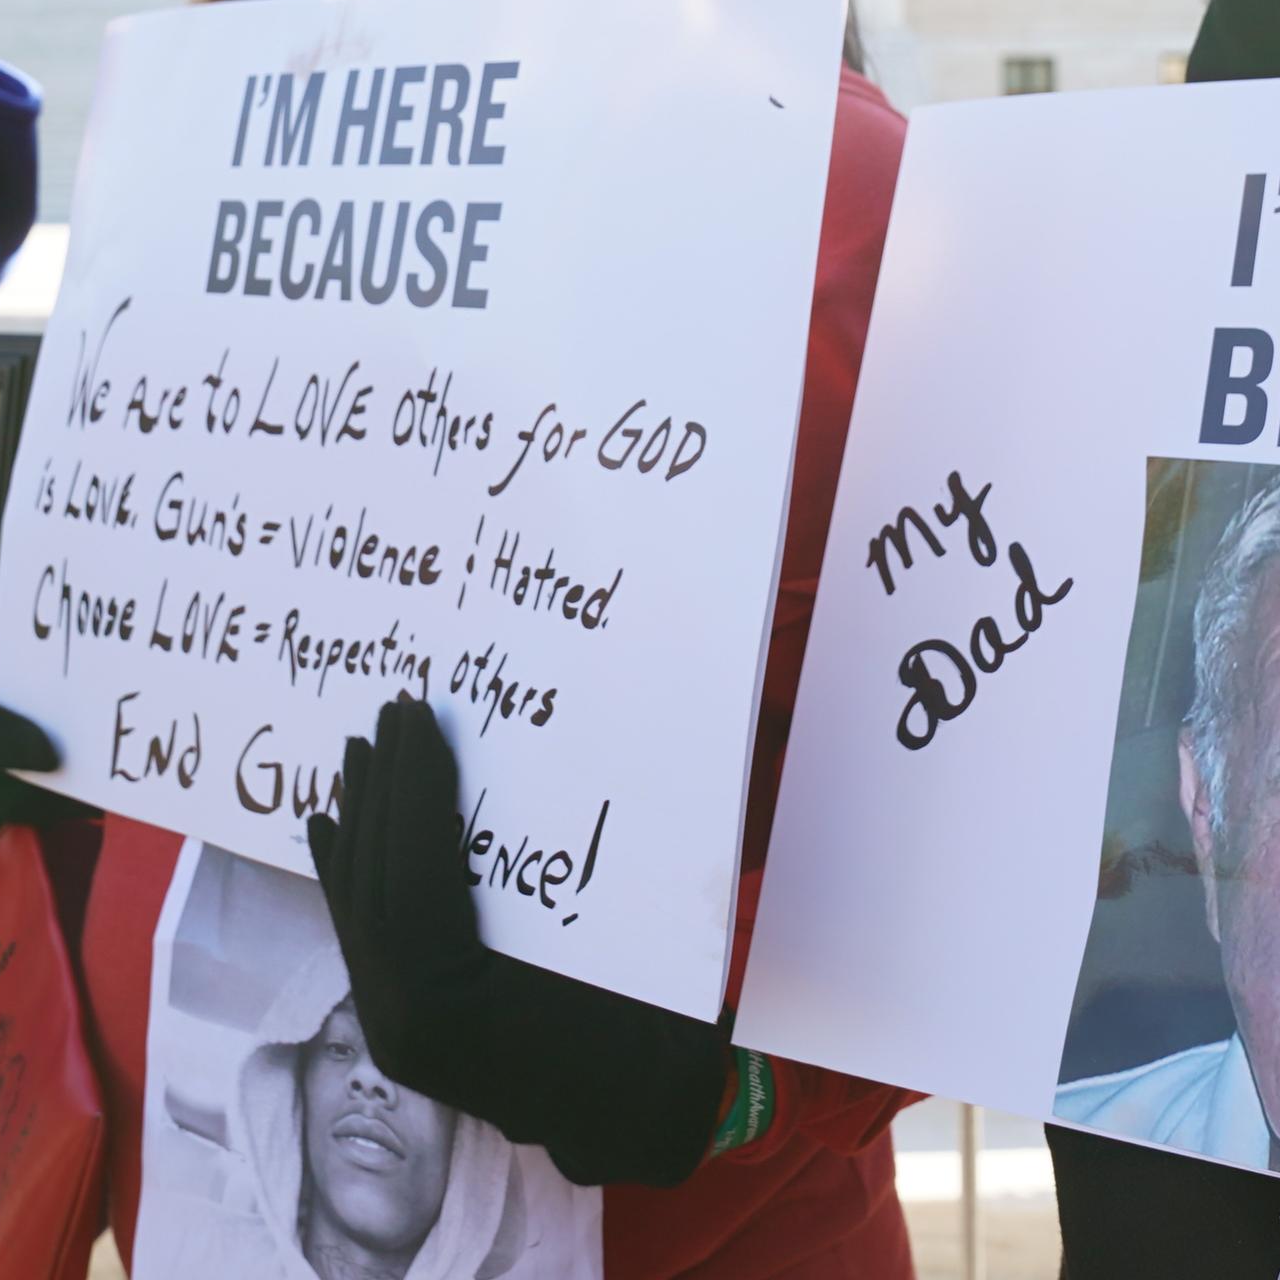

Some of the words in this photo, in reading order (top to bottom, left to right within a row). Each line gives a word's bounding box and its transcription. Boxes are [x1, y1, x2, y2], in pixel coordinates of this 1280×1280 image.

[230, 72, 326, 168] I'M
[331, 61, 520, 166] HERE
[206, 198, 503, 310] BECAUSE
[66, 296, 131, 432] We
[201, 347, 241, 435] to
[248, 356, 374, 448] LOVE
[487, 402, 588, 497] for
[597, 398, 708, 483] GOD
[35, 458, 56, 516] is
[32, 558, 136, 678] Choose
[149, 577, 246, 663] LOVE
[896, 541, 1074, 751] Dad
